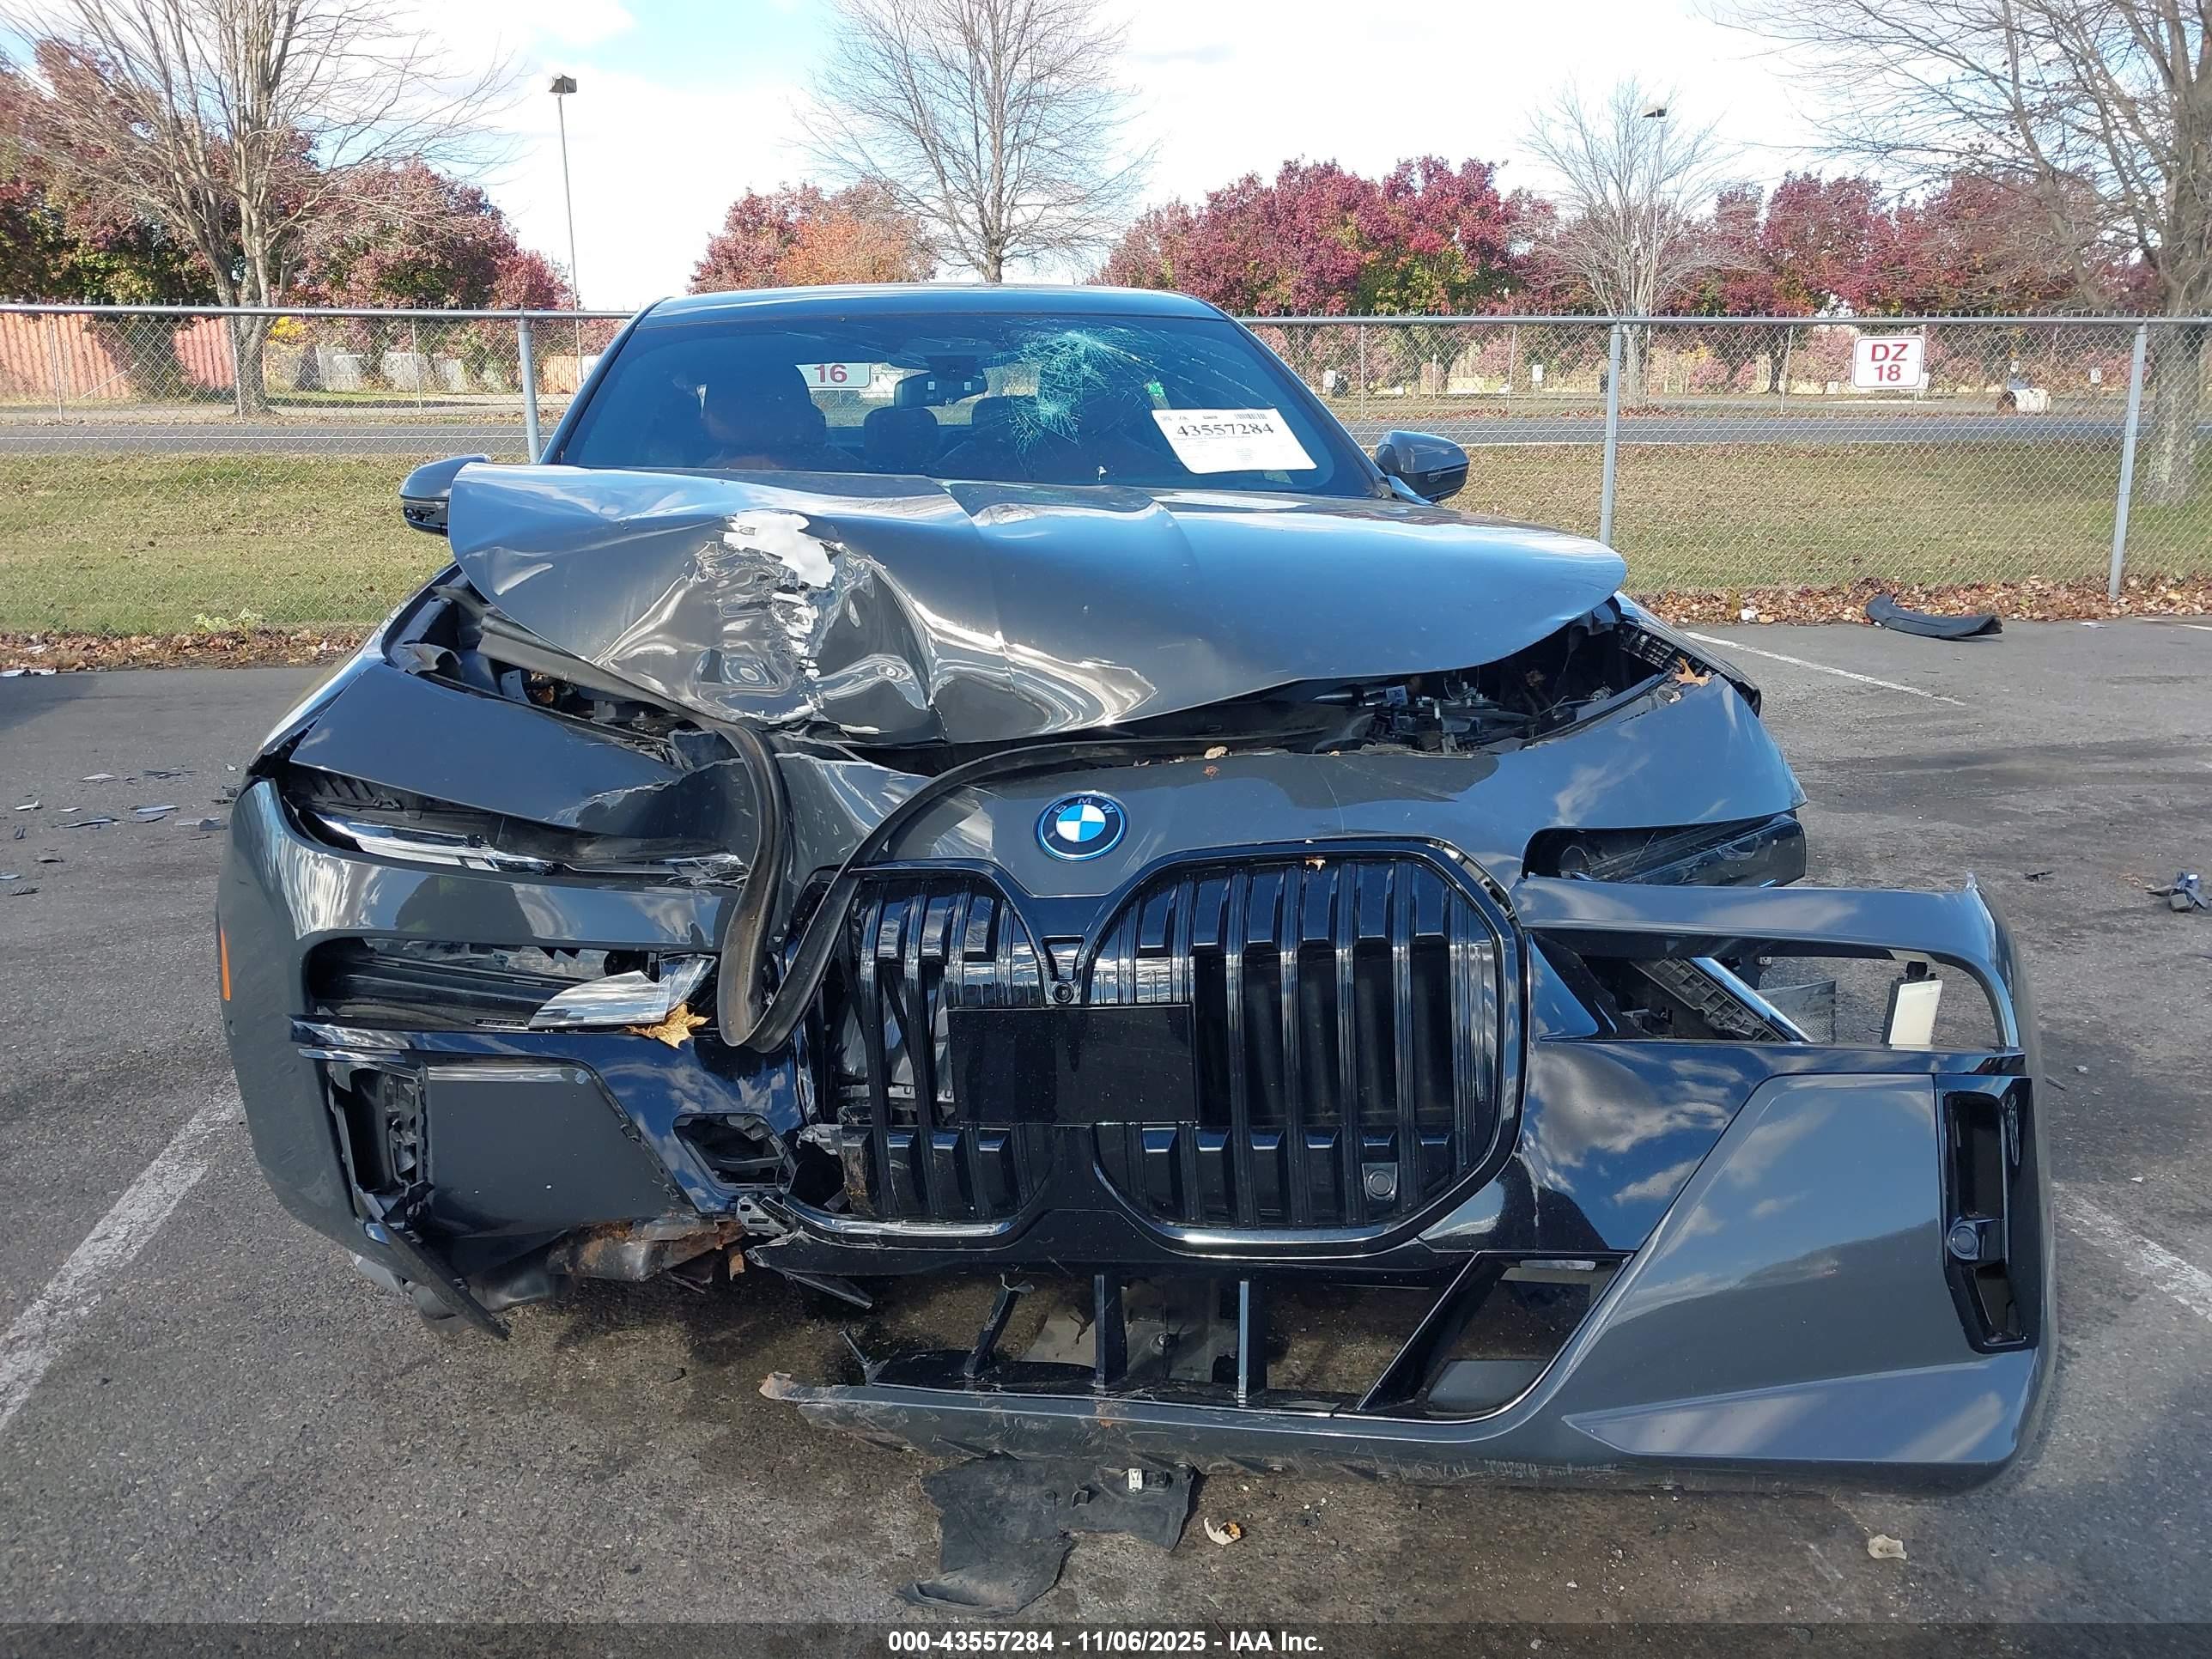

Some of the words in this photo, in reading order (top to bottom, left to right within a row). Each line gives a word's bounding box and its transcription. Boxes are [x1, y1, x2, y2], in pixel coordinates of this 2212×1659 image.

[1870, 343, 1909, 362] DZ
[814, 363, 848, 383] 16
[1874, 363, 1901, 382] 18
[1176, 422, 1274, 436] 43557284
[1053, 797, 1116, 814] BMW
